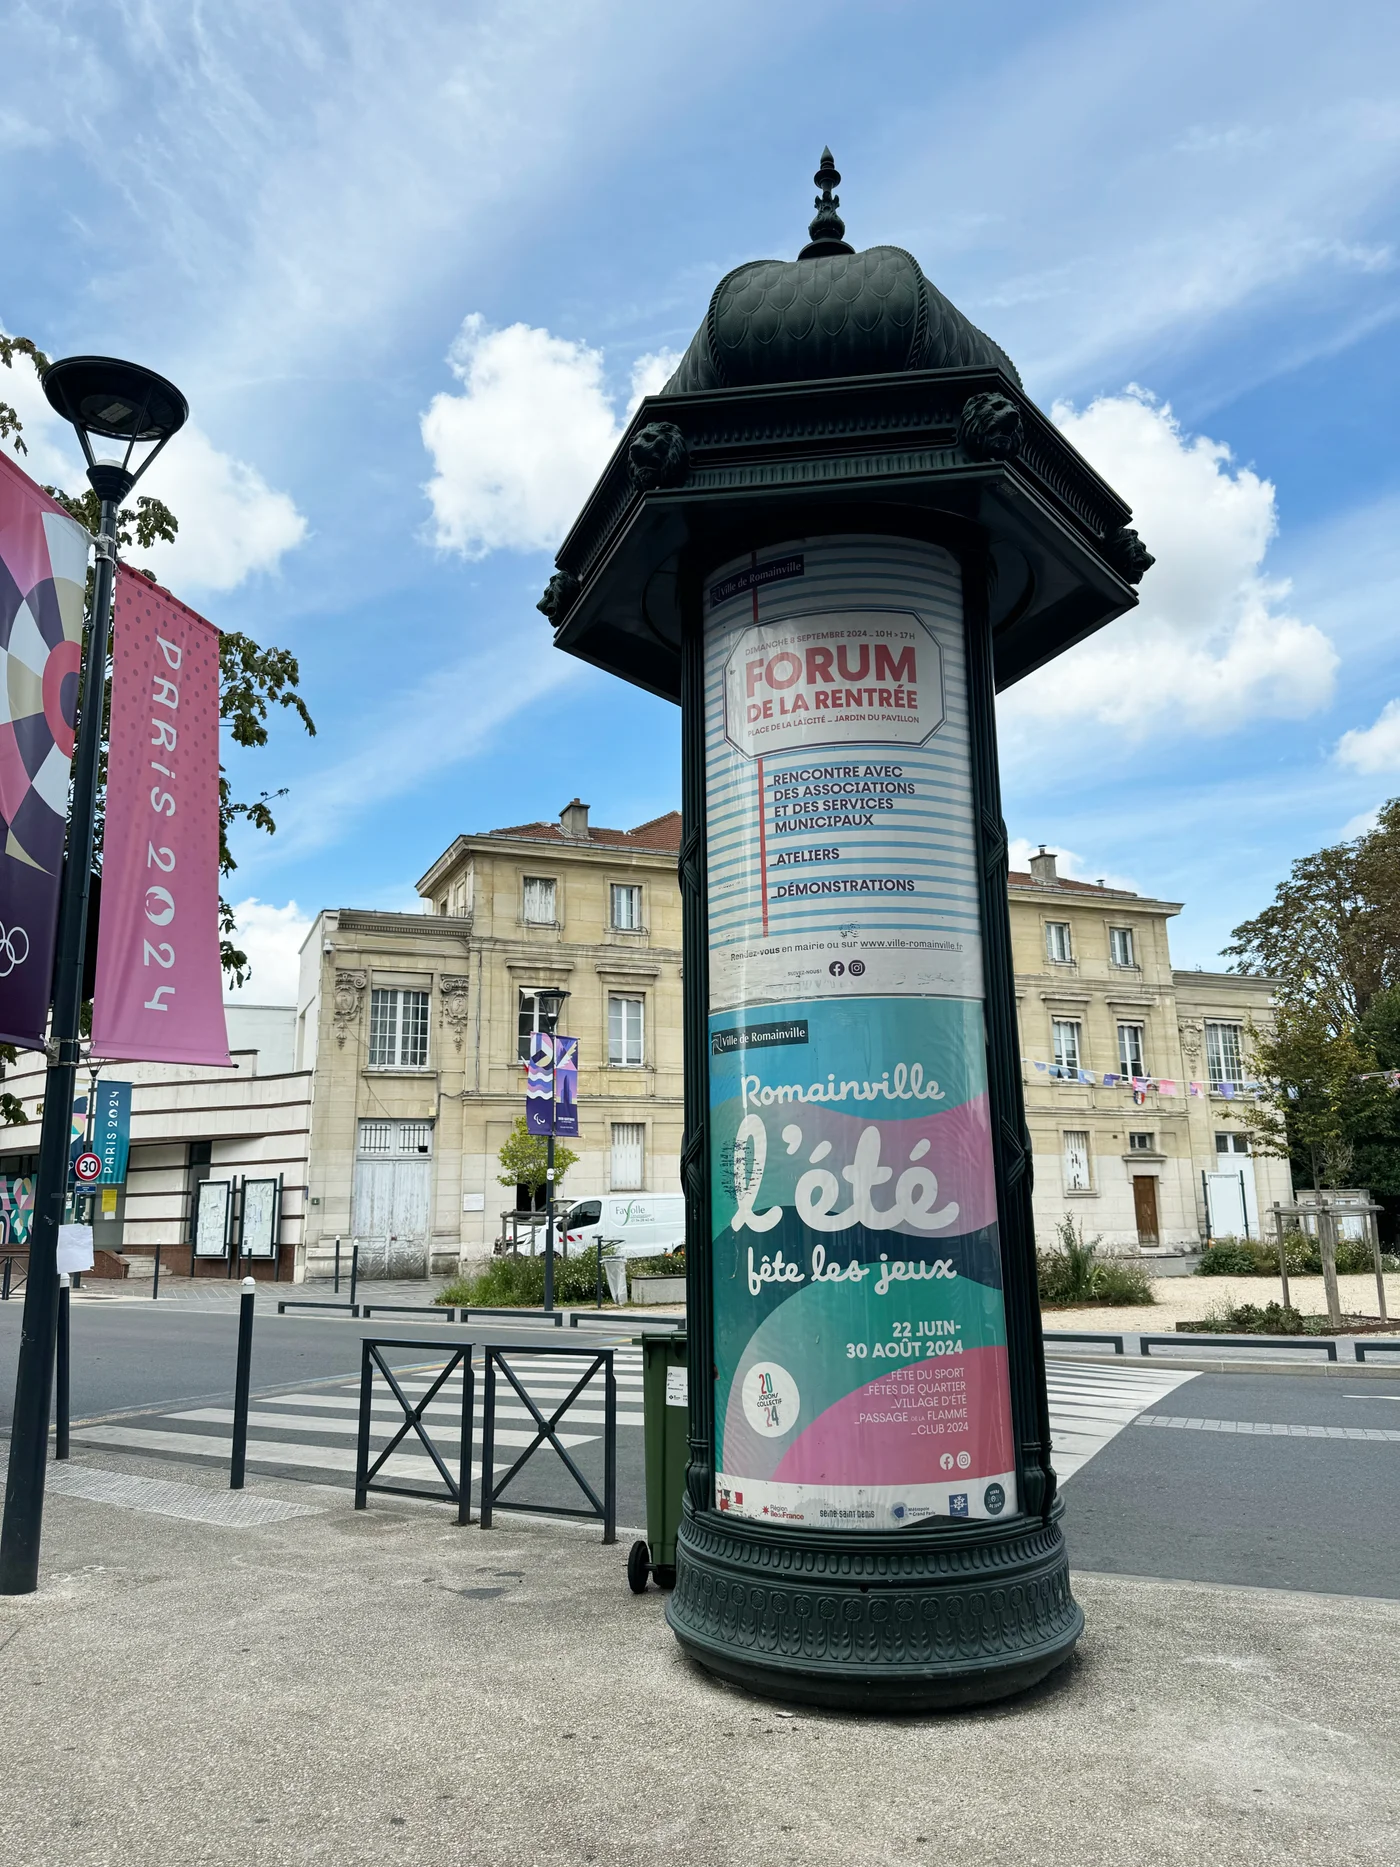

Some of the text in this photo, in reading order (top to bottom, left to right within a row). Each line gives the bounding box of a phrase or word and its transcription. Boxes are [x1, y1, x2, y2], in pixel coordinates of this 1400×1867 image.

[720, 562, 801, 596] Ville de Romainville
[745, 636, 789, 656] DIMANCHE
[790, 636, 795, 644] 8
[796, 631, 845, 643] SEPTEMBRE
[847, 630, 868, 638] 2024
[745, 644, 917, 699] FORUM
[747, 684, 918, 724] DE LA RENTRÉE
[747, 724, 769, 738] PLACE
[770, 722, 781, 731] DE
[782, 720, 792, 729] LA
[794, 715, 826, 728] LAÏCITÉ
[834, 713, 866, 723] JARDIN
[868, 714, 880, 722] DU
[881, 714, 920, 724] PAVILLON
[864, 766, 903, 778] AVEC
[774, 782, 915, 802] DES ASSOCIATIONS
[774, 798, 894, 818] ET DES SERVICES
[775, 814, 874, 834] MUNICIPAUX
[730, 938, 963, 962] Rendez-vous en mairie ou sur www.ville-romainville.fr
[722, 1026, 806, 1047] Ville de Romainville
[741, 1062, 946, 1109] Romainville
[81, 1160, 97, 1174] 30
[746, 1244, 958, 1296] fête les jeux
[892, 1319, 962, 1338] 22 JUIN-
[845, 1338, 964, 1359] 30 AOÛT 2024
[758, 1372, 773, 1395] 20
[916, 1370, 933, 1381] DU
[934, 1367, 965, 1380] SPORT
[900, 1384, 915, 1395] DE
[917, 1381, 966, 1395] QUARTIER
[764, 1405, 780, 1427] 24
[927, 1407, 968, 1421] FLAMME
[946, 1421, 969, 1433] 2024
